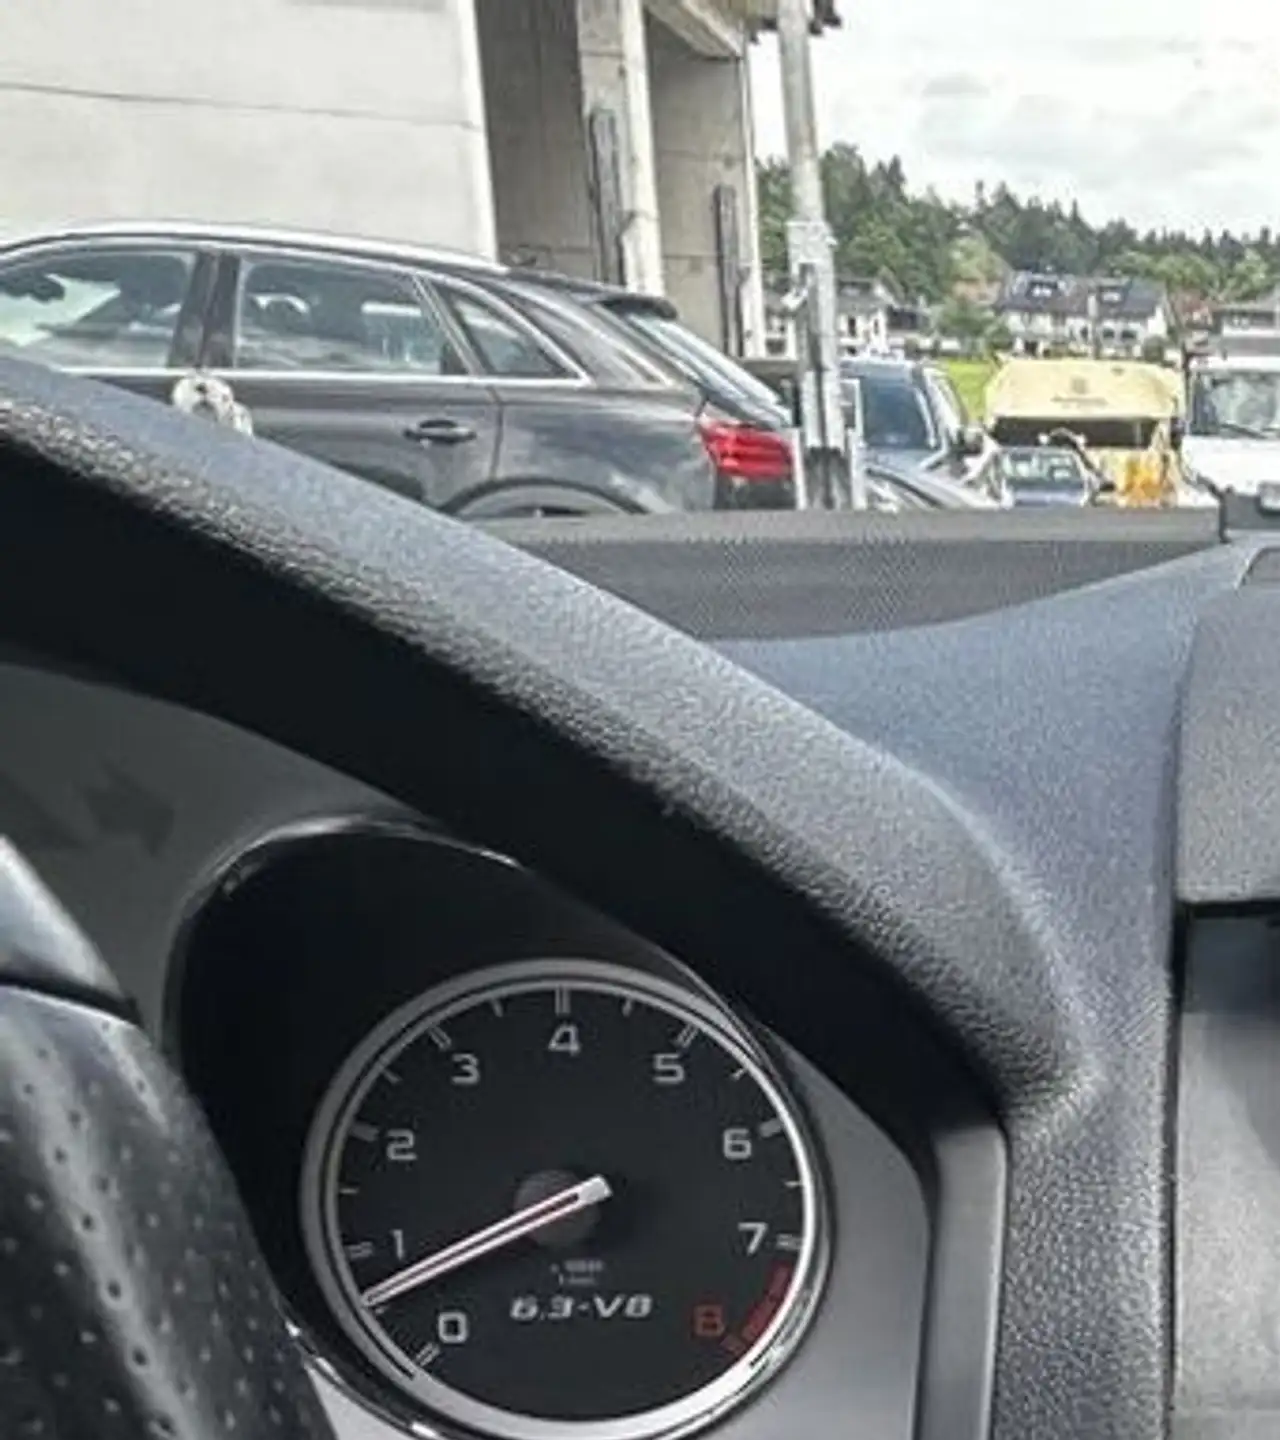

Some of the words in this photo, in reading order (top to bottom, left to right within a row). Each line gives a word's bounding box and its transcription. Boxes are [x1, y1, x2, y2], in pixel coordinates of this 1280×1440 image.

[547, 1025, 583, 1055] 4
[451, 1053, 481, 1086] 3
[652, 1053, 686, 1084] 5
[386, 1129, 418, 1162] 2
[722, 1128, 754, 1160] 6
[392, 1230, 405, 1259] 1
[737, 1222, 769, 1255] 7
[436, 1311, 468, 1345] 0
[692, 1305, 725, 1337] 8
